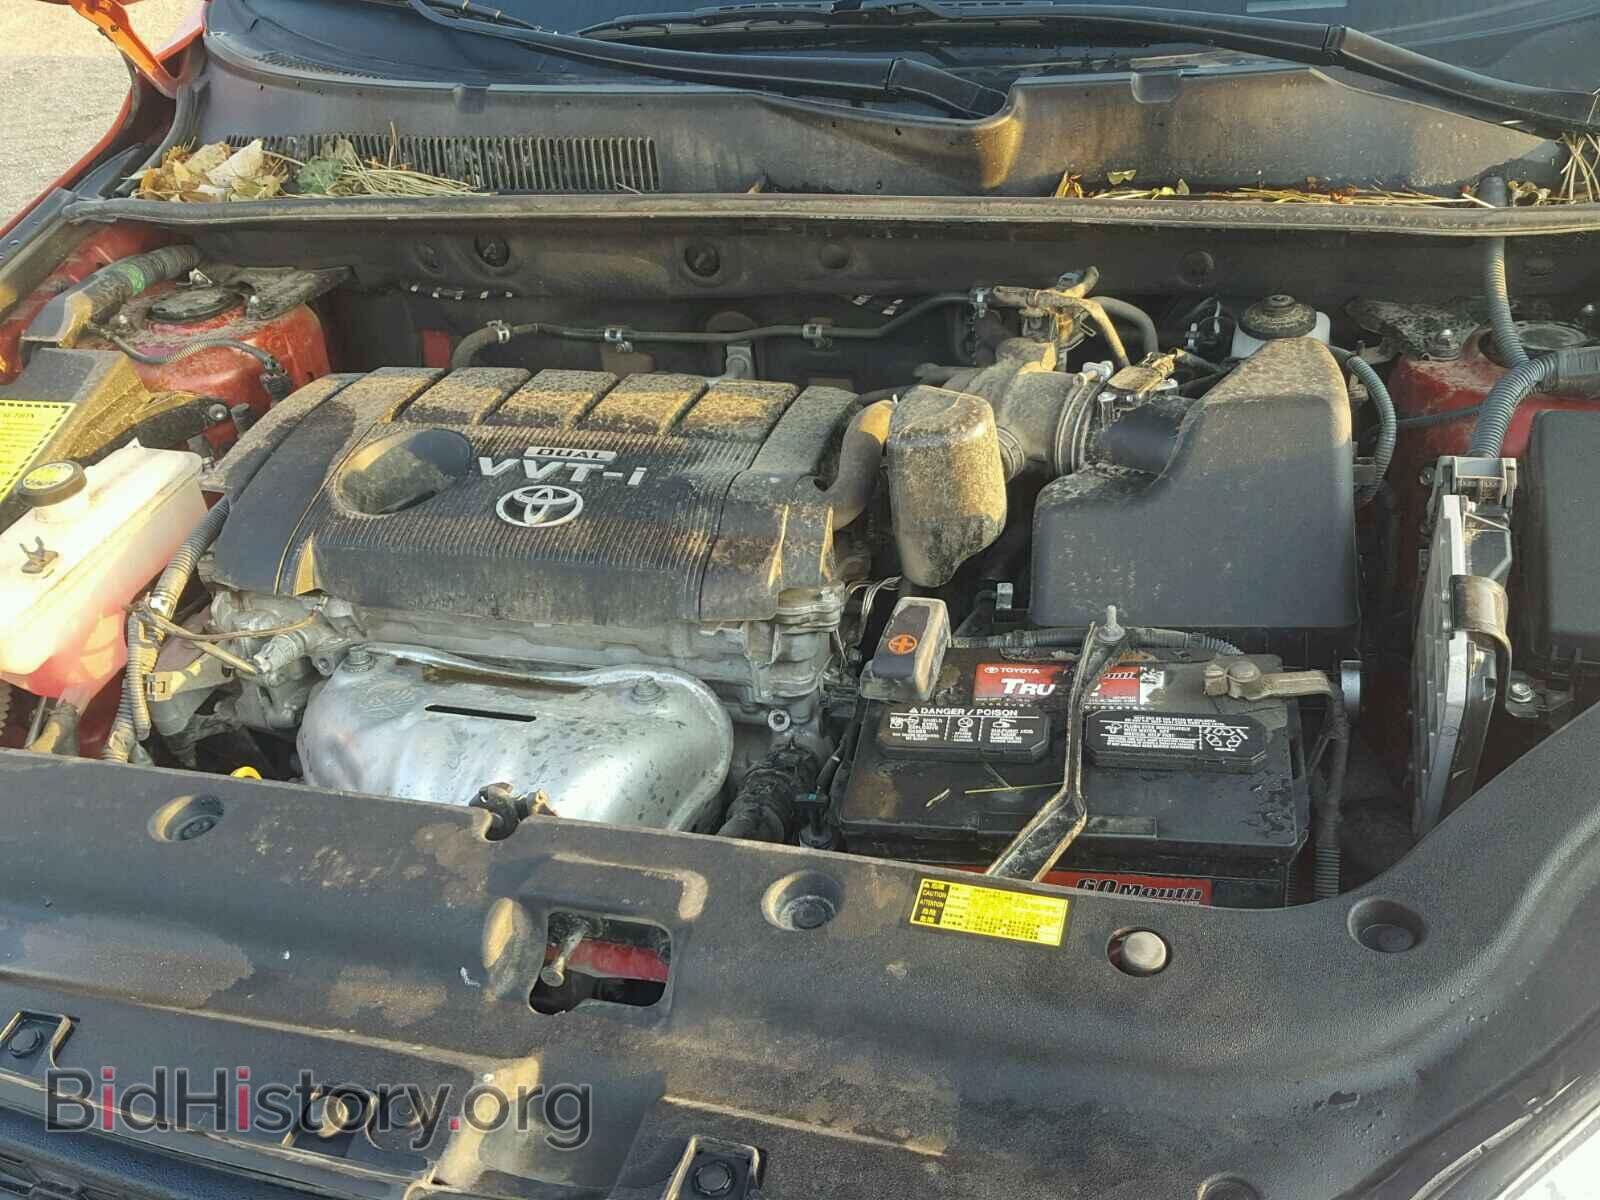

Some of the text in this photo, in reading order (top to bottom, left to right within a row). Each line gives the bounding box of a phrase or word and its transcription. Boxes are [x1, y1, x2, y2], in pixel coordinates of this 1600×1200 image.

[536, 447, 605, 460] DUAL
[478, 456, 648, 486] VVT-i
[920, 707, 966, 715] DANGER
[976, 709, 1018, 717] POISON
[922, 889, 947, 899] CAUTION
[919, 898, 945, 908] ATTENTION
